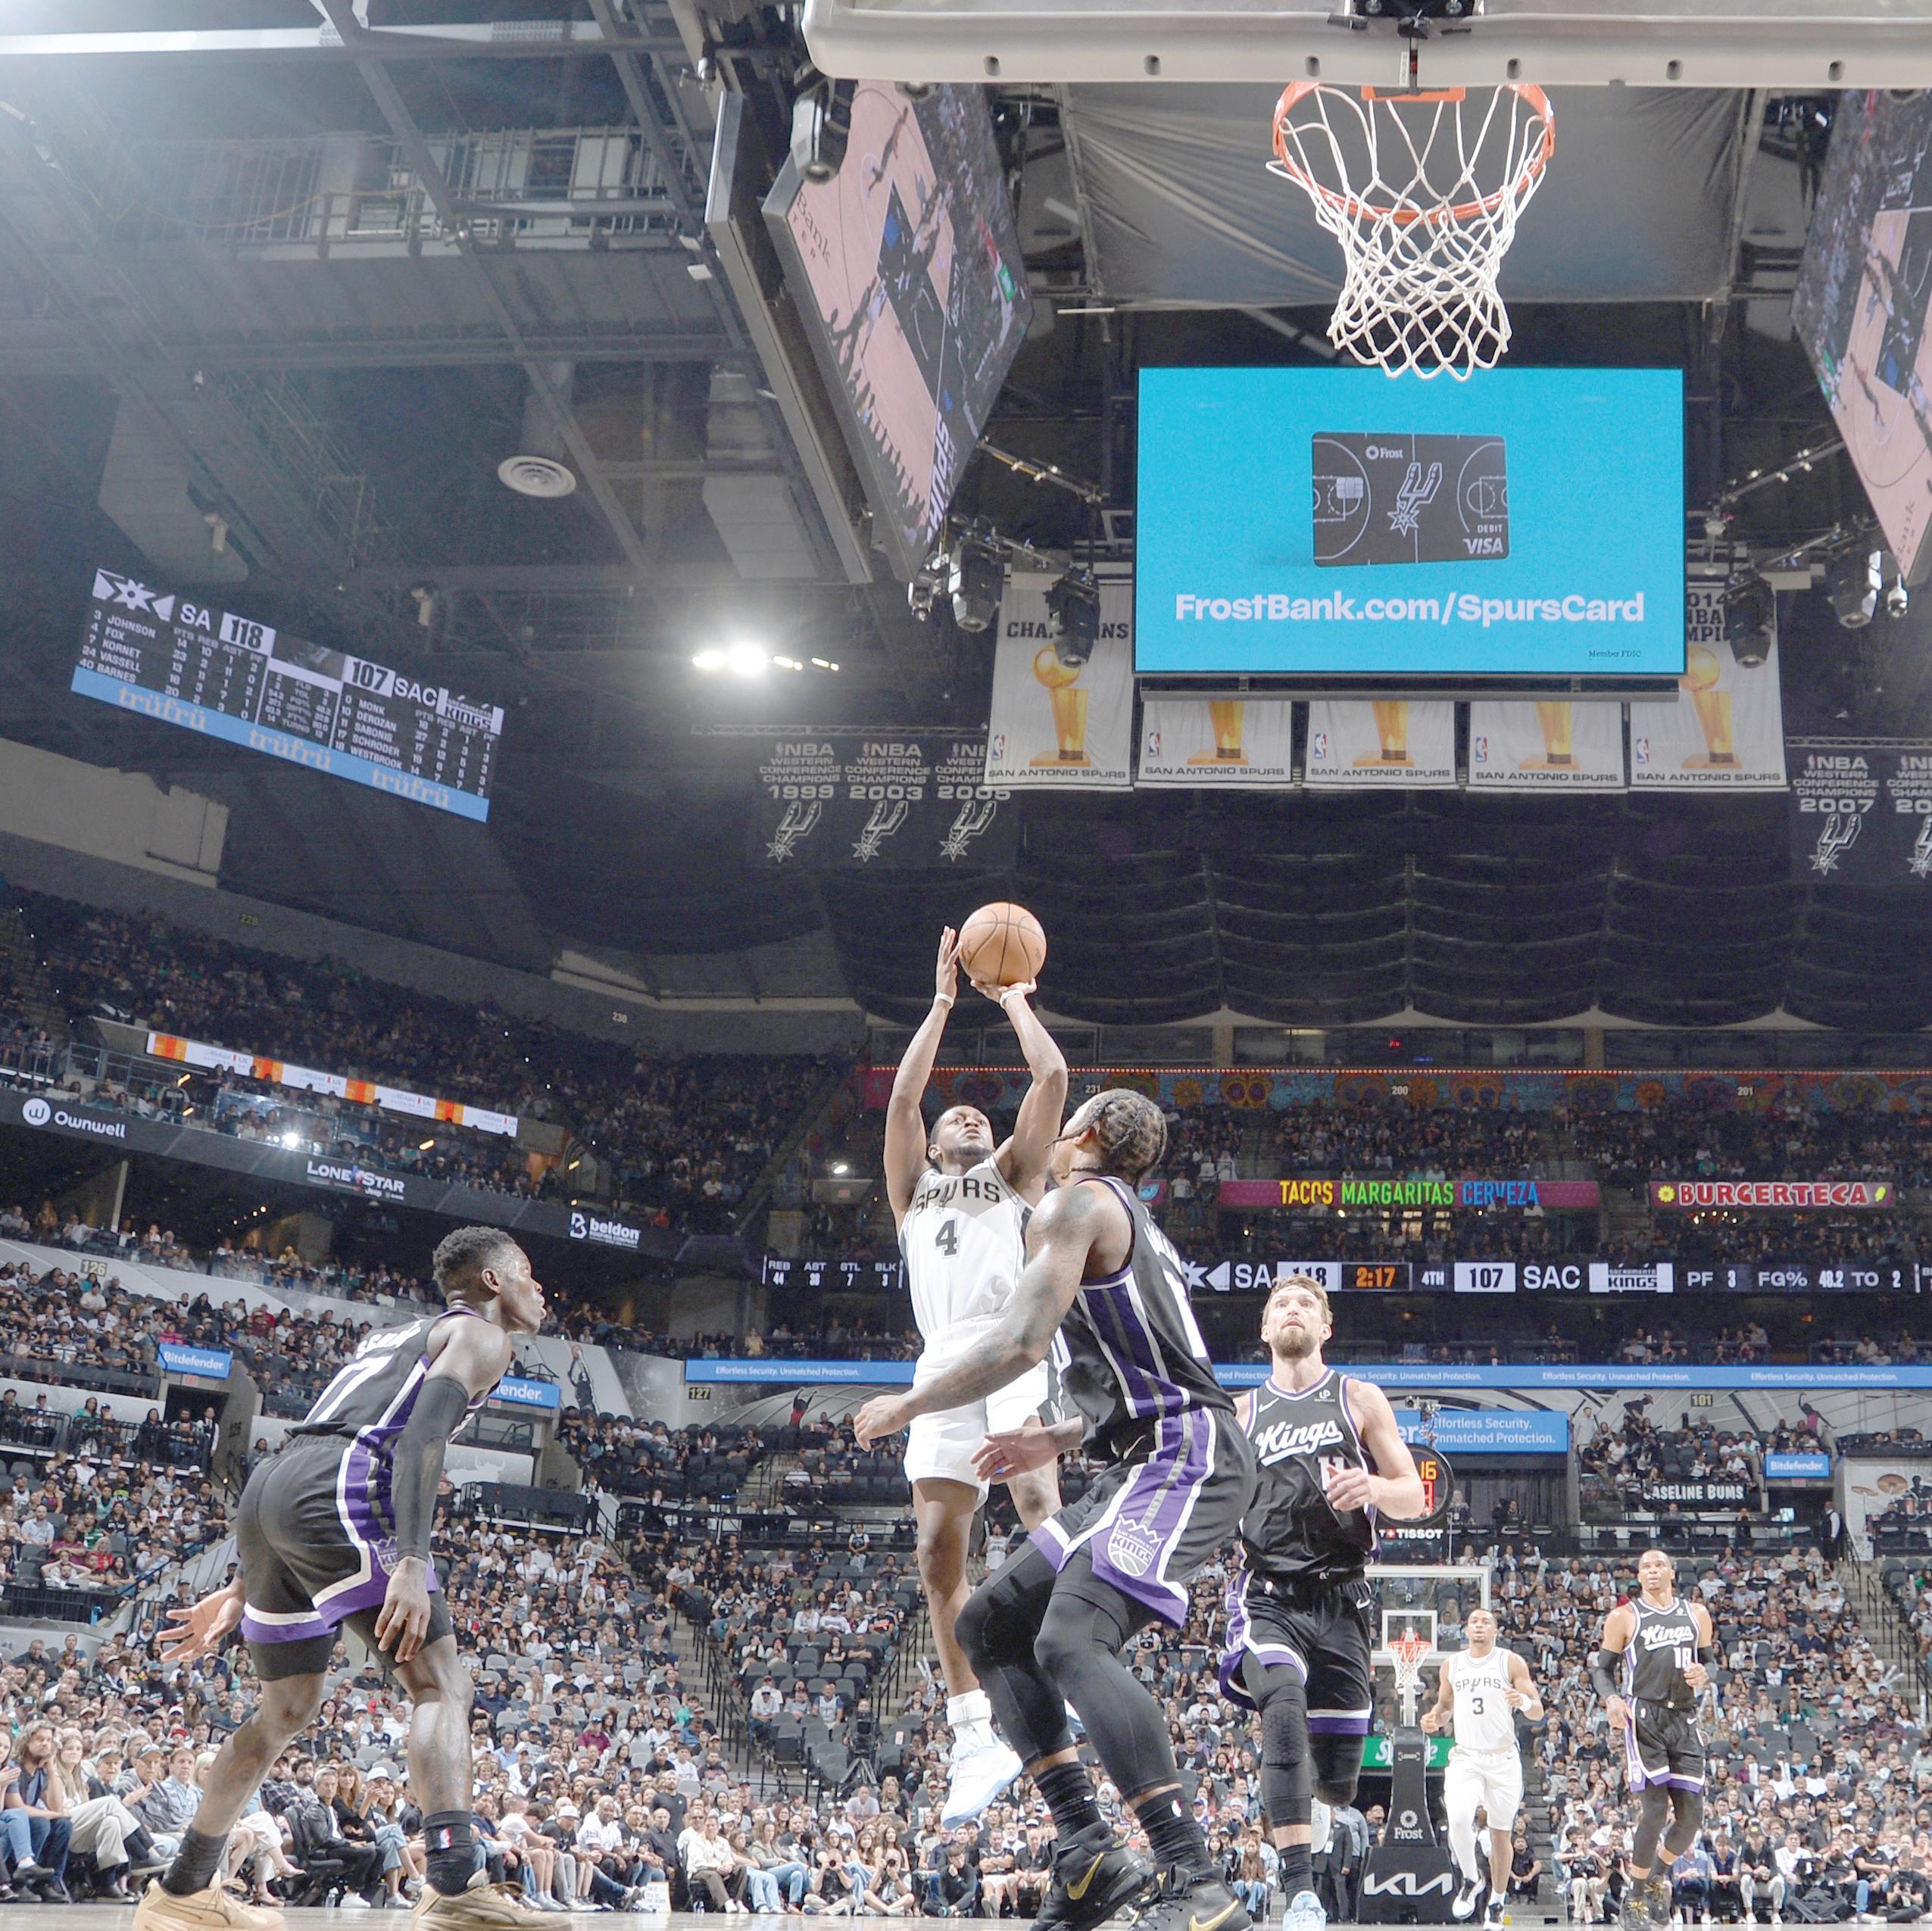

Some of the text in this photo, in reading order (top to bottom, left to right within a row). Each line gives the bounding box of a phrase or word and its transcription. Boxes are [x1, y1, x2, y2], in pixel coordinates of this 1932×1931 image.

[797, 192, 830, 268] Bank
[1380, 448, 1403, 459] Frost
[927, 411, 949, 544] SPUR
[1478, 525, 1503, 533] DEBIT
[1463, 538, 1503, 554] VISA
[1687, 594, 1726, 607] 014
[1175, 591, 1645, 628] FrostBank.com/SpursCard
[94, 610, 156, 638] 3 JOHNSON
[1687, 609, 1722, 625] BA
[91, 622, 125, 641] 4 FOX
[180, 604, 264, 650] SA 118
[1007, 622, 1129, 639] CHANS
[89, 634, 142, 660] 7 KORNET
[82, 645, 142, 673] 24 VASSELL
[80, 658, 137, 684] 40 BARNES
[352, 661, 389, 691] 107
[394, 677, 437, 707] SAC
[119, 685, 207, 731] trüfrü
[345, 695, 385, 716] 0 MONK
[342, 706, 398, 732] 10 DEROZAN
[338, 728, 347, 739] 17
[341, 717, 394, 742] 11 SABONIS
[248, 728, 332, 772] trüfrü
[336, 741, 404, 769] 18 WESTBROOK
[784, 744, 835, 756] NBA
[872, 743, 922, 757] NBA
[857, 757, 921, 766] WESTERN
[1816, 756, 1869, 769] NBA
[760, 766, 841, 774] CONFERENCE
[845, 766, 931, 775] CONFERENCE
[988, 769, 1126, 778] SAN ANTONIO SPURS
[1145, 766, 1284, 775] SAN ANTONIO SPURS
[1311, 768, 1450, 778] SAN ANTONIO SPURS
[1475, 771, 1618, 781] SAN ANTONIO SPURS
[1637, 772, 1781, 781] SAN ANTONIO SPURS
[1803, 770, 1868, 778] WESTERN
[763, 774, 840, 783] CHAMPIONS
[847, 775, 927, 784] CHAMPIONS
[1793, 779, 1879, 788] CONFERENCE
[370, 768, 450, 810] trüfrü
[768, 785, 835, 800] 1999
[849, 786, 923, 800] 2003
[1796, 788, 1877, 797] CHAMPIONS
[1799, 799, 1874, 813] 2007
[1896, 799, 1932, 813] 20
[1085, 1084, 1100, 1094] 231
[1391, 1086, 1409, 1096] 200
[1737, 1086, 1753, 1096] 201
[54, 1111, 127, 1139] Ownwell
[307, 1160, 352, 1182] LONE
[361, 1171, 404, 1193] STAR
[916, 1178, 1000, 1216] SPURS
[1279, 1180, 1333, 1205] TACOS
[1341, 1181, 1454, 1205] MARGARITAS
[1678, 1183, 1868, 1206] BURGERTECA
[590, 1217, 641, 1240] beldon
[935, 1218, 959, 1257] 4
[83, 1262, 106, 1275] 126
[768, 1259, 897, 1272] REB AST STL BLK
[772, 1272, 785, 1286] 44
[847, 1273, 854, 1286] 7
[1234, 1263, 1273, 1288] SA
[1356, 1266, 1397, 1287] 2:17
[1421, 1271, 1444, 1285] 4TH
[1469, 1268, 1503, 1288] 107
[1523, 1265, 1581, 1290] SAC
[1608, 1276, 1658, 1288] KINGS
[1687, 1272, 1714, 1287] PF
[1728, 1271, 1737, 1288] 3
[1758, 1272, 1808, 1287] FG%
[1818, 1270, 1844, 1288] 48.2
[1850, 1271, 1879, 1287] TO
[1892, 1270, 1902, 1288] 2
[715, 1367, 748, 1375] Effortless
[779, 1368, 821, 1376] Unmatched
[1234, 1371, 1274, 1380] Protection
[1400, 1372, 1437, 1380] Unmatched
[1543, 1372, 1575, 1380] Effortless
[1751, 1373, 1783, 1381] Effortless
[689, 1389, 710, 1399] 127
[1692, 1395, 1712, 1406] 101
[1485, 1417, 1532, 1430] Security.
[1255, 1420, 1344, 1466] Kings
[1437, 1431, 1556, 1444] nmatched Protection.
[1706, 1484, 1744, 1500] BUMS
[1396, 1528, 1444, 1539] TISSOT
[1112, 1535, 1152, 1565] KINGS
[1640, 1624, 1694, 1651] Kings
[1672, 1647, 1693, 1669] 18
[1455, 1677, 1501, 1692] SPURS
[1472, 1697, 1484, 1715] 3
[1394, 1826, 1424, 1840] Frost
[1363, 1873, 1453, 1895] KIA
